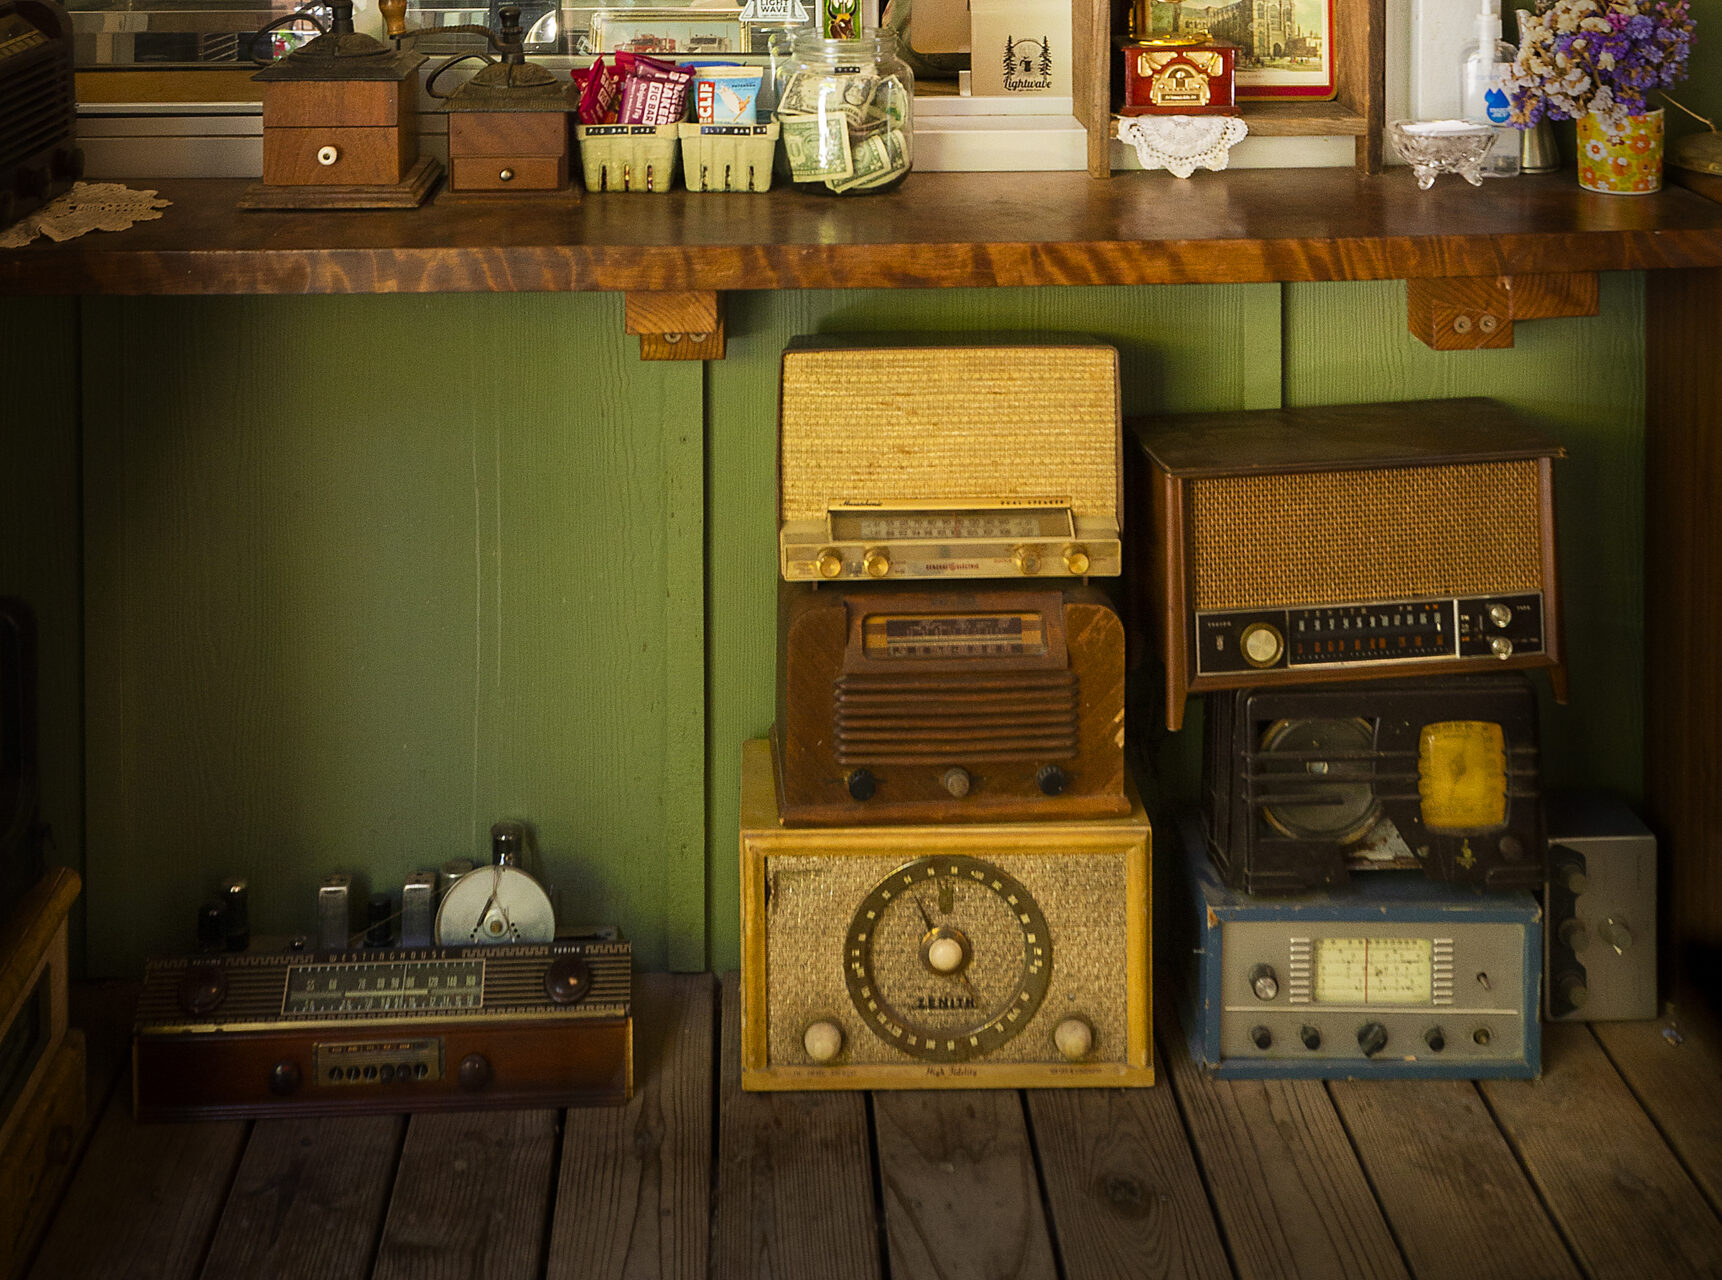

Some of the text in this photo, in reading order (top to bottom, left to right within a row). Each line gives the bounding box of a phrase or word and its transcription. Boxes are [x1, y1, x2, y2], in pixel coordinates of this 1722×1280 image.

[1003, 79, 1052, 91] Lightwave
[632, 83, 648, 120] Original Fig
[646, 85, 660, 122] FIG BAR
[699, 84, 713, 117] CLIF
[329, 951, 446, 963] WESTINGHOUSE
[917, 996, 976, 1009] ZENITH
